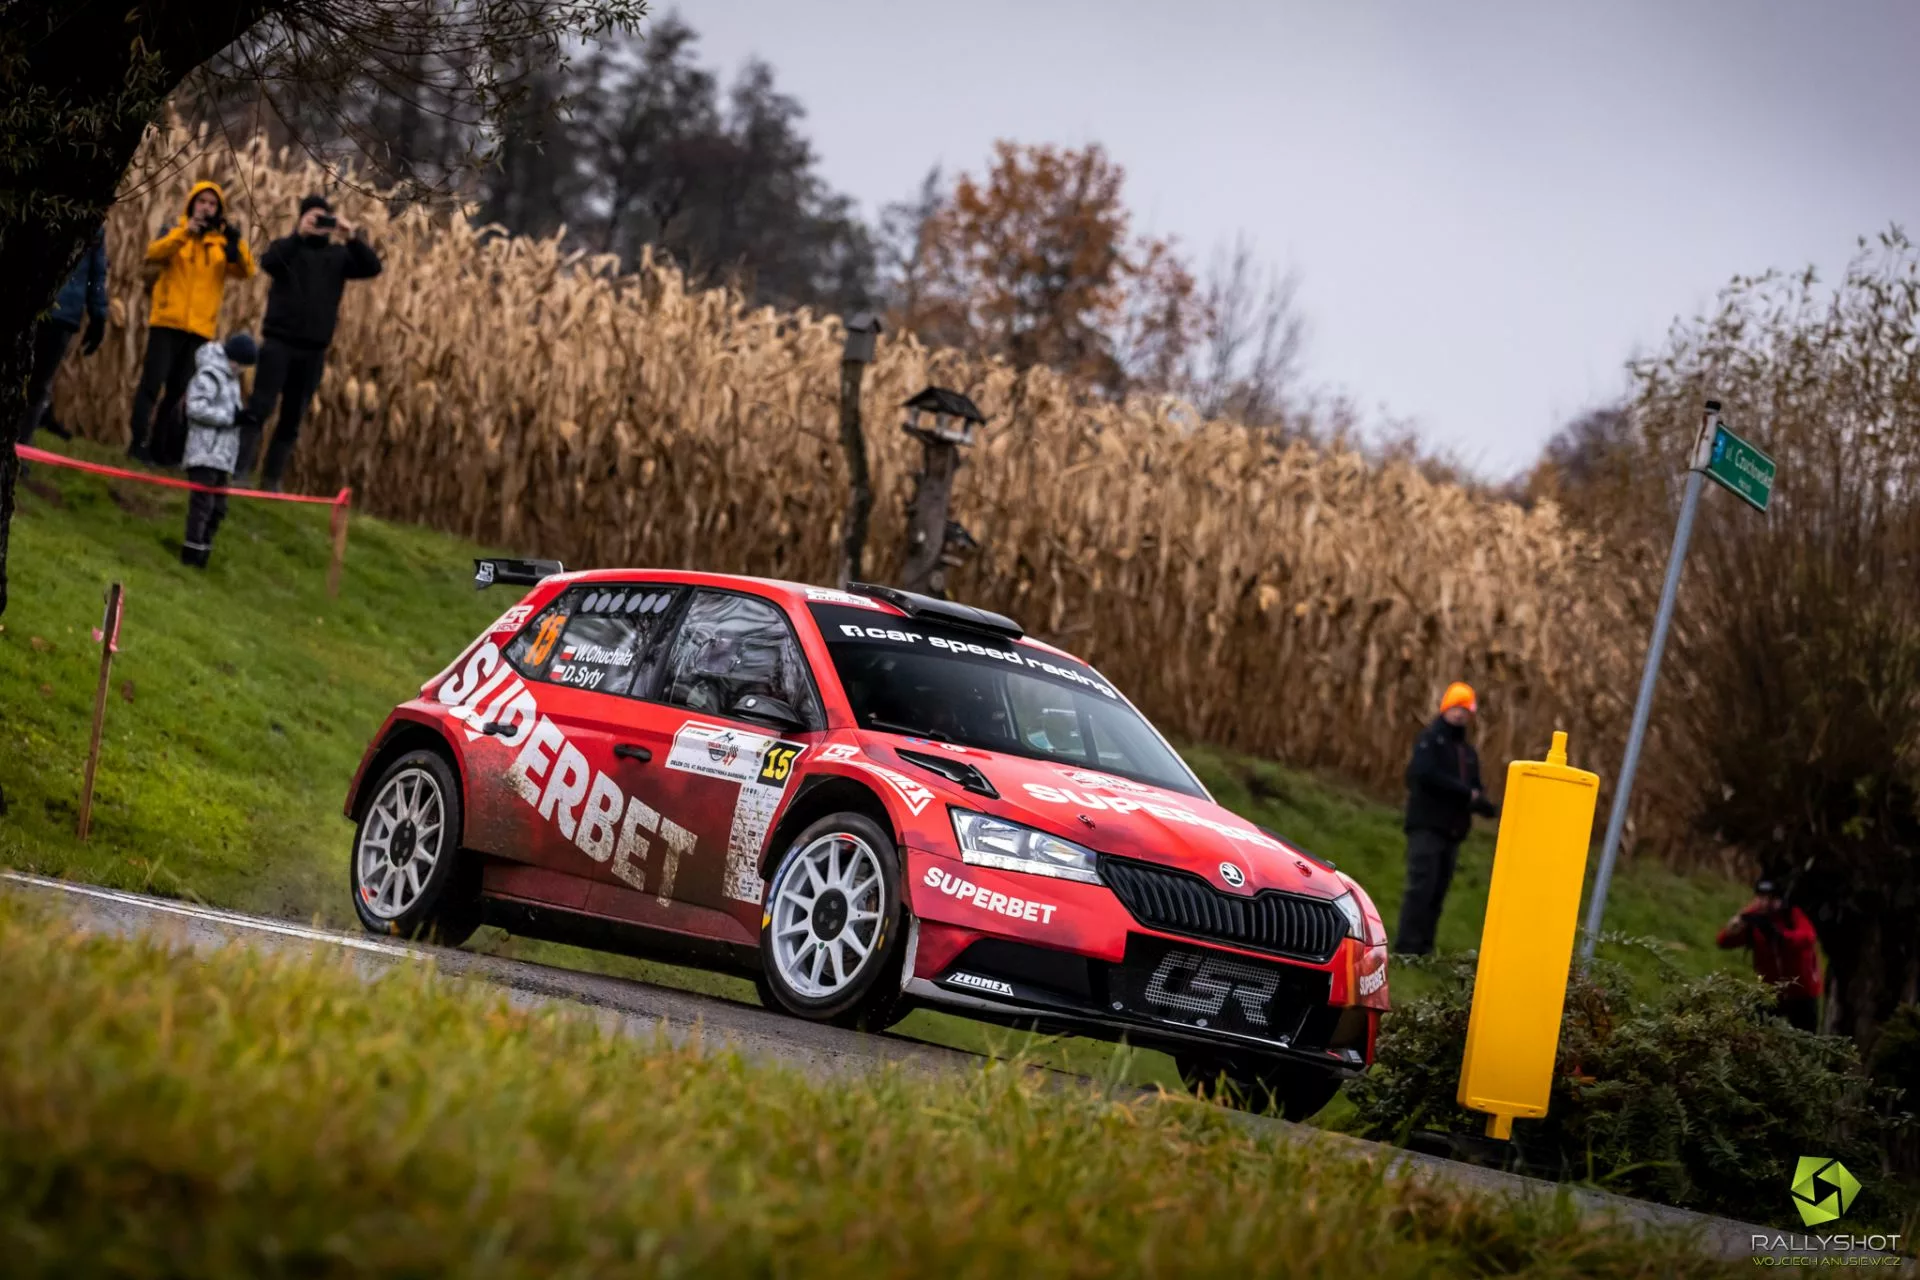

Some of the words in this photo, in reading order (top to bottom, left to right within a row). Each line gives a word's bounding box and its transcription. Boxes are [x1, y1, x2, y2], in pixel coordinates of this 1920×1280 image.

[524, 614, 567, 666] 15
[866, 627, 923, 643] car
[928, 635, 1024, 665] speed
[1025, 656, 1118, 700] racing
[562, 664, 606, 690] D.Syty
[438, 641, 698, 907] SUPERBET
[762, 748, 796, 780] 15
[923, 866, 1057, 924] SUPERBET
